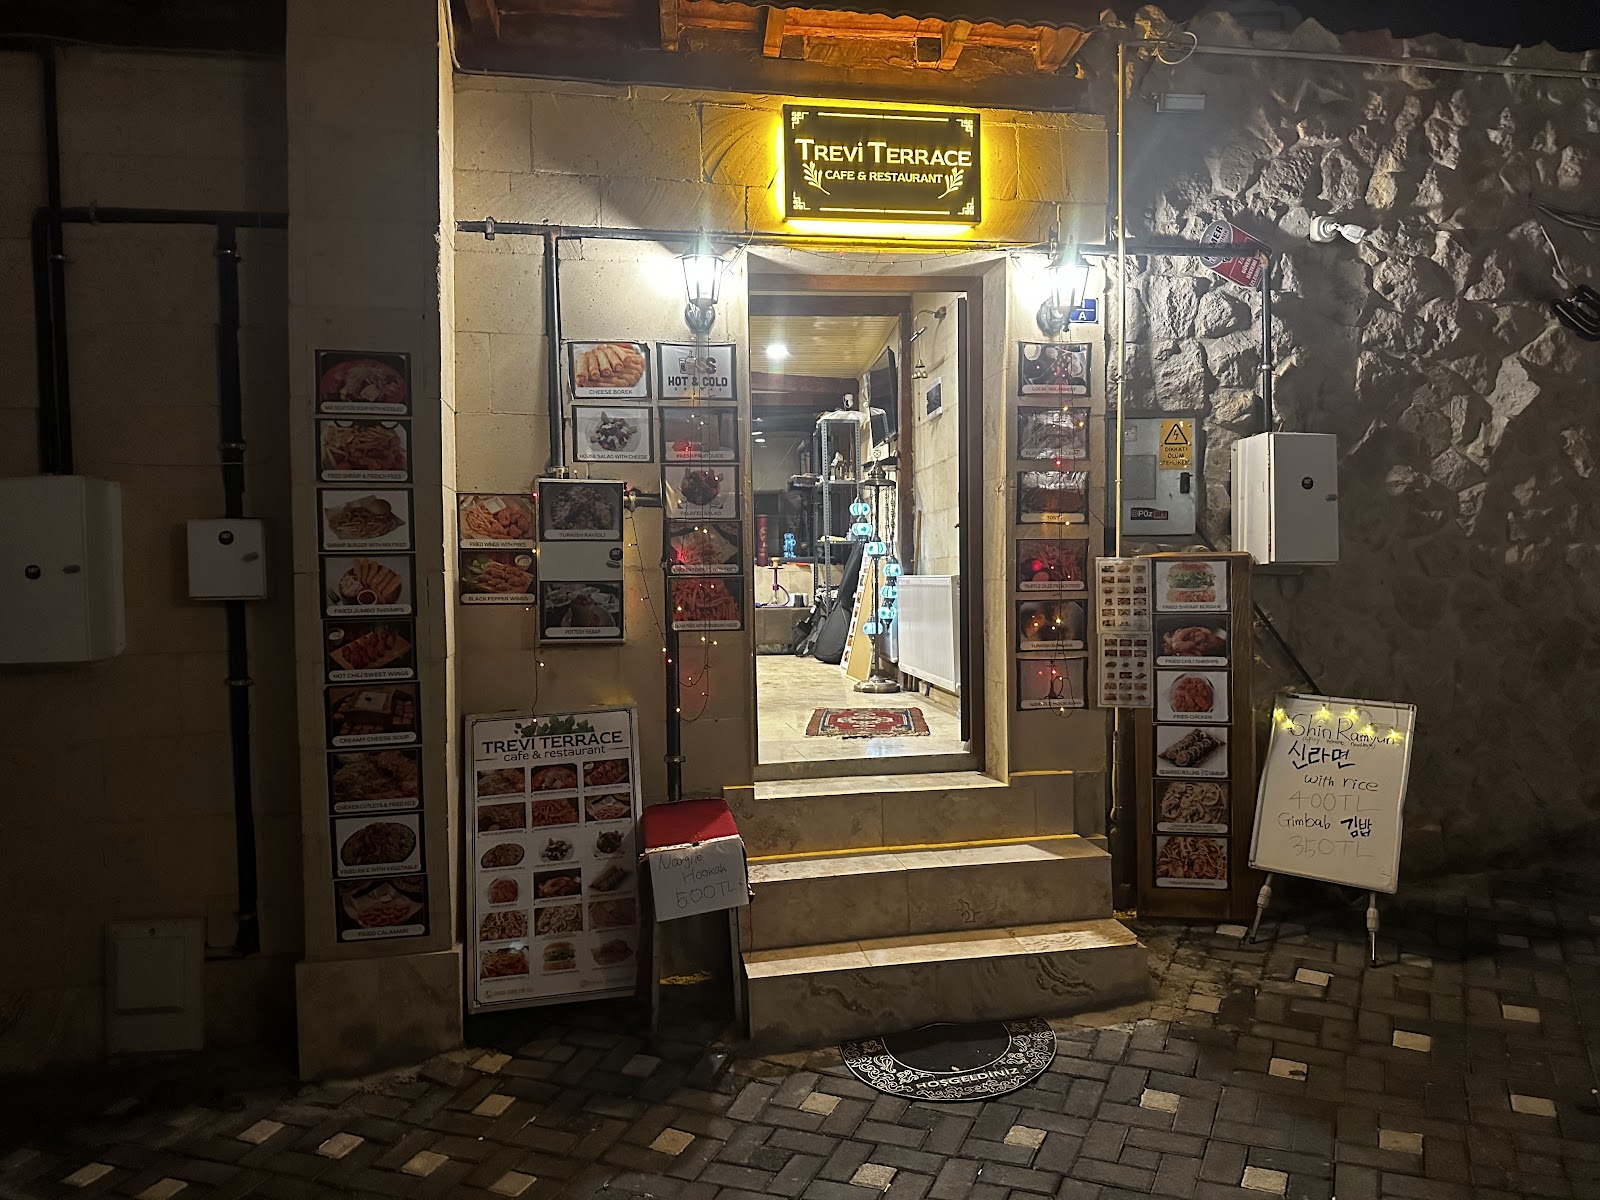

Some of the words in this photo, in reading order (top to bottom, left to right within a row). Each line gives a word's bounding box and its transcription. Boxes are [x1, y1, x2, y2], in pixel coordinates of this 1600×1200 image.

[867, 141, 973, 167] TERRACE
[824, 170, 855, 181] CAFE
[857, 171, 867, 181] &
[869, 171, 944, 184] RESTAURANT
[1078, 311, 1087, 320] A
[668, 376, 688, 386] HOT
[692, 376, 699, 387] &
[703, 376, 728, 387] COLD
[1289, 713, 1332, 739] Shin
[482, 738, 535, 754] TREVI
[540, 731, 623, 749] TERRACE
[504, 751, 529, 762] cafe
[532, 751, 541, 759] &
[544, 745, 606, 758] restaurant
[1288, 740, 1355, 769] 신라면
[1304, 774, 1334, 787] with
[1342, 778, 1379, 792] rice
[1278, 812, 1331, 830] Gimbab
[1341, 815, 1373, 838] 김밥
[377, 928, 409, 936] CALAMARI
